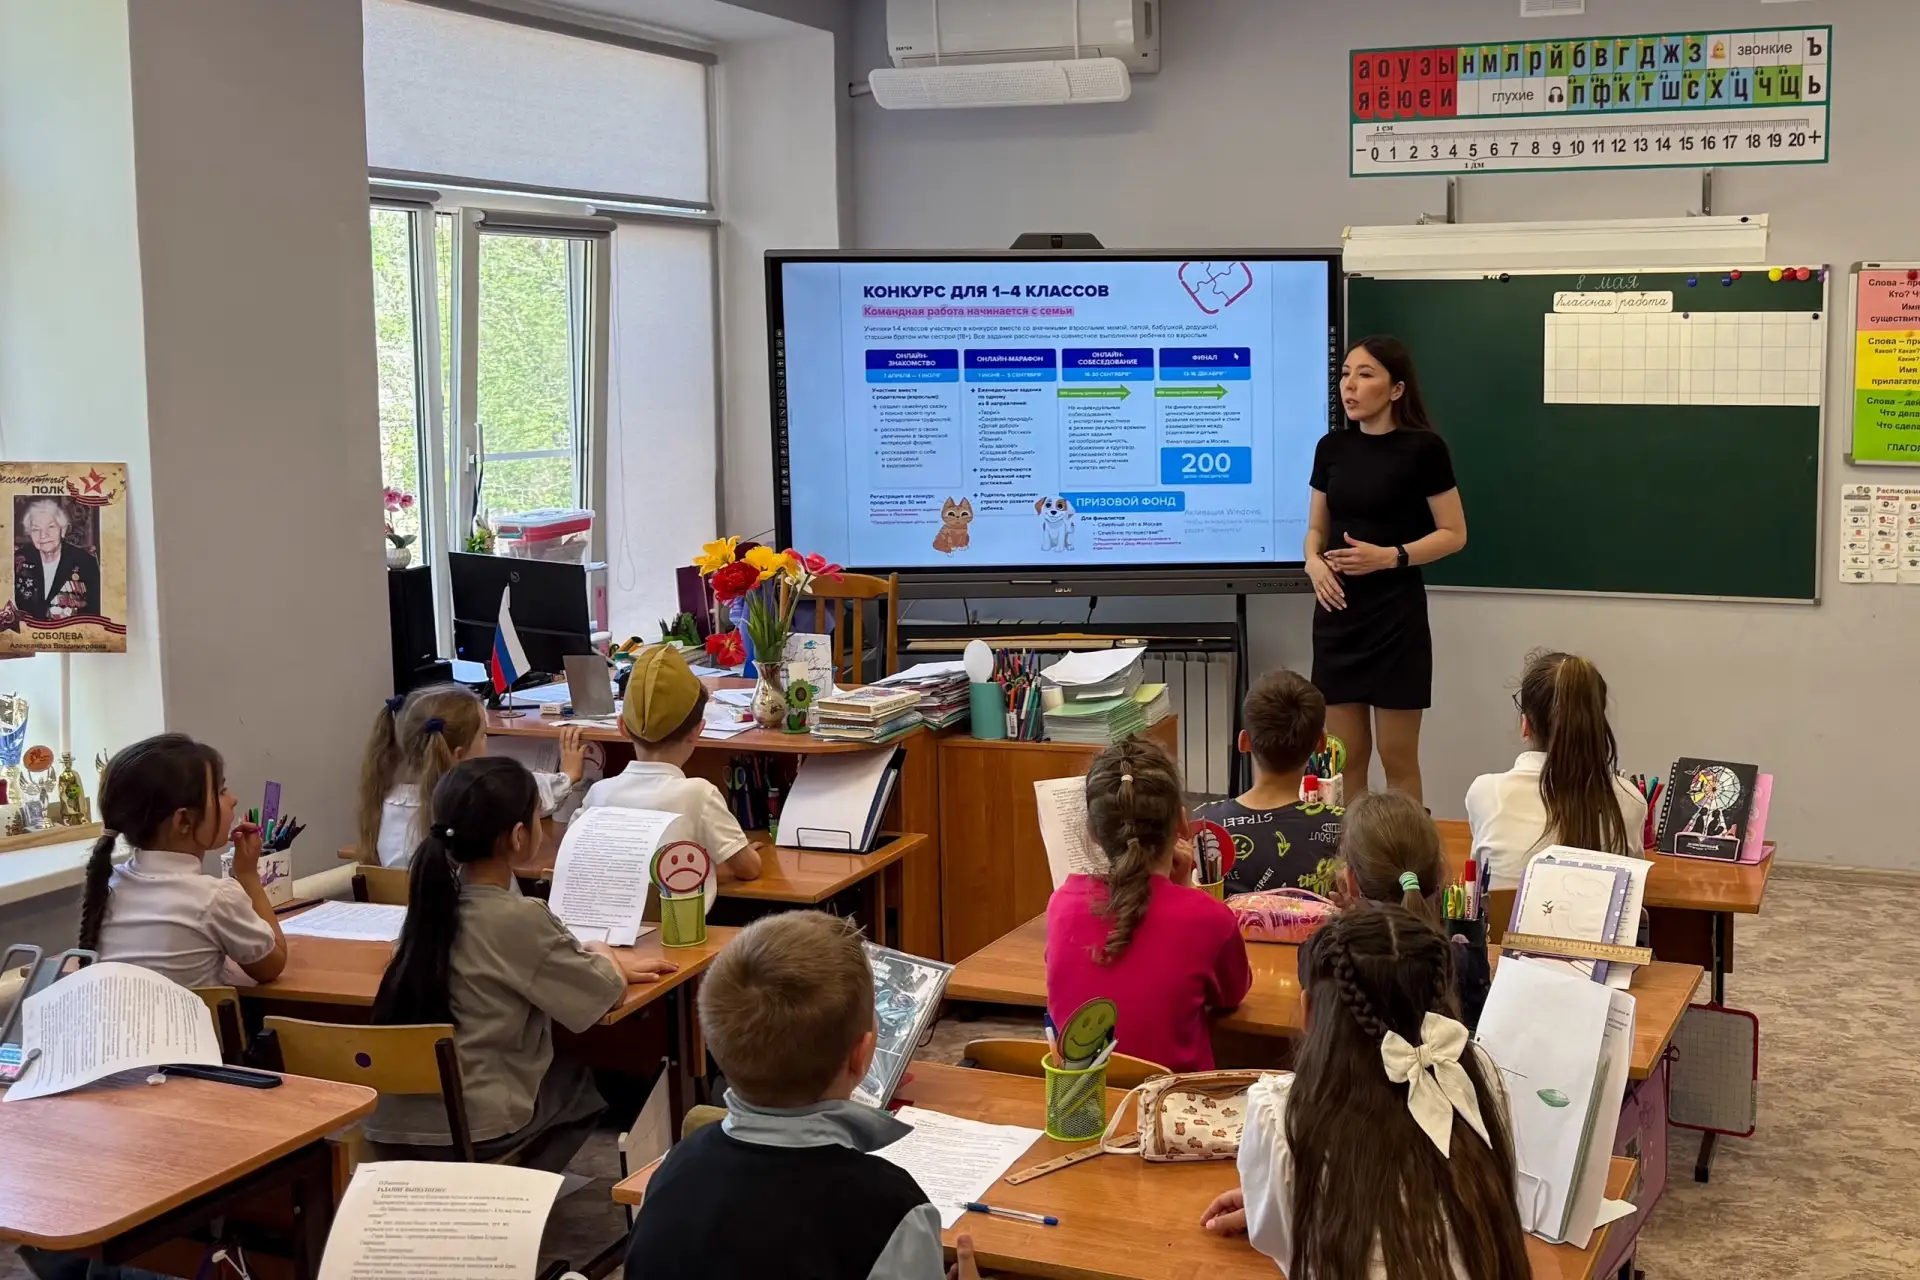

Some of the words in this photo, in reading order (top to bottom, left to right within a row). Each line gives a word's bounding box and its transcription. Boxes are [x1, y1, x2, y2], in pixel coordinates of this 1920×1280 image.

[1359, 60, 1370, 79] а
[1378, 59, 1390, 78] о
[1398, 58, 1410, 82] у
[1420, 57, 1431, 76] э
[1439, 56, 1454, 75] ы
[1463, 55, 1474, 74] н
[1483, 54, 1497, 73] м
[1505, 53, 1519, 72] л
[1529, 51, 1542, 76] р
[1550, 44, 1563, 69] й
[1573, 43, 1586, 68] б
[1595, 47, 1608, 67] в
[1619, 47, 1630, 66] г
[1640, 45, 1655, 69] д
[1663, 44, 1680, 64] ж
[1688, 43, 1701, 63] з
[1737, 43, 1793, 56] звонкие
[1359, 91, 1370, 111] я
[1378, 86, 1390, 110] ё
[1397, 89, 1412, 109] ю
[1420, 88, 1431, 108] е
[1441, 88, 1453, 107] и
[1492, 91, 1534, 104] глухие
[1572, 85, 1584, 104] п
[1593, 79, 1611, 109] ф
[1619, 83, 1630, 102] к
[1641, 82, 1654, 102] т
[1662, 80, 1680, 100] ш
[1687, 79, 1699, 100] с
[1710, 79, 1723, 99] х
[1734, 78, 1748, 102] ц
[1758, 76, 1772, 97] ч
[1780, 75, 1799, 100] щ
[1371, 147, 1379, 160] 0
[1389, 146, 1396, 160] 1
[1409, 145, 1418, 159] 2
[1430, 144, 1439, 158] 3
[1449, 144, 1458, 157] 4
[1468, 143, 1477, 157] 5
[1490, 142, 1499, 156] 6
[1510, 142, 1519, 155] 7
[1531, 141, 1540, 155] 8
[1552, 141, 1561, 155] 9
[1570, 140, 1585, 154] 10
[1592, 139, 1605, 153] 11
[1611, 138, 1627, 153] 12
[1633, 138, 1648, 152] 13
[1655, 137, 1671, 151] 14
[1679, 136, 1694, 151] 15
[1700, 135, 1716, 150] 16
[1722, 134, 1738, 149] 17
[1745, 134, 1761, 148] 18
[1766, 133, 1782, 148] 19
[1788, 132, 1806, 147] 20
[1576, 274, 1586, 290] 8
[1594, 275, 1640, 290] мая
[1868, 278, 1897, 287] Слова
[863, 285, 946, 298] КОНКУРС
[951, 285, 987, 300] ДЛЯ
[1025, 284, 1109, 297] КЛАССОВ
[1888, 290, 1910, 298] Кто?
[1556, 293, 1613, 307] Классная
[1617, 292, 1669, 313] работа
[864, 307, 924, 317] Командная
[928, 305, 964, 319] работа
[967, 306, 1029, 316] начинается
[1031, 307, 1037, 315] с
[1040, 306, 1073, 315] семьи
[1870, 316, 1920, 324] существит
[1868, 337, 1897, 345] Слова
[1866, 397, 1896, 405] Слова
[1879, 408, 1896, 417] Что
[1876, 421, 1893, 429] Что
[1181, 452, 1231, 473] 200
[0, 473, 69, 486] ессмертный
[32, 485, 65, 494] ПОЛК
[1076, 495, 1139, 507] ПРИЗОВОЙ
[1141, 496, 1176, 506] ФОНД
[32, 632, 84, 641] СОБОЛЕВА
[1223, 812, 1273, 828] STREET
